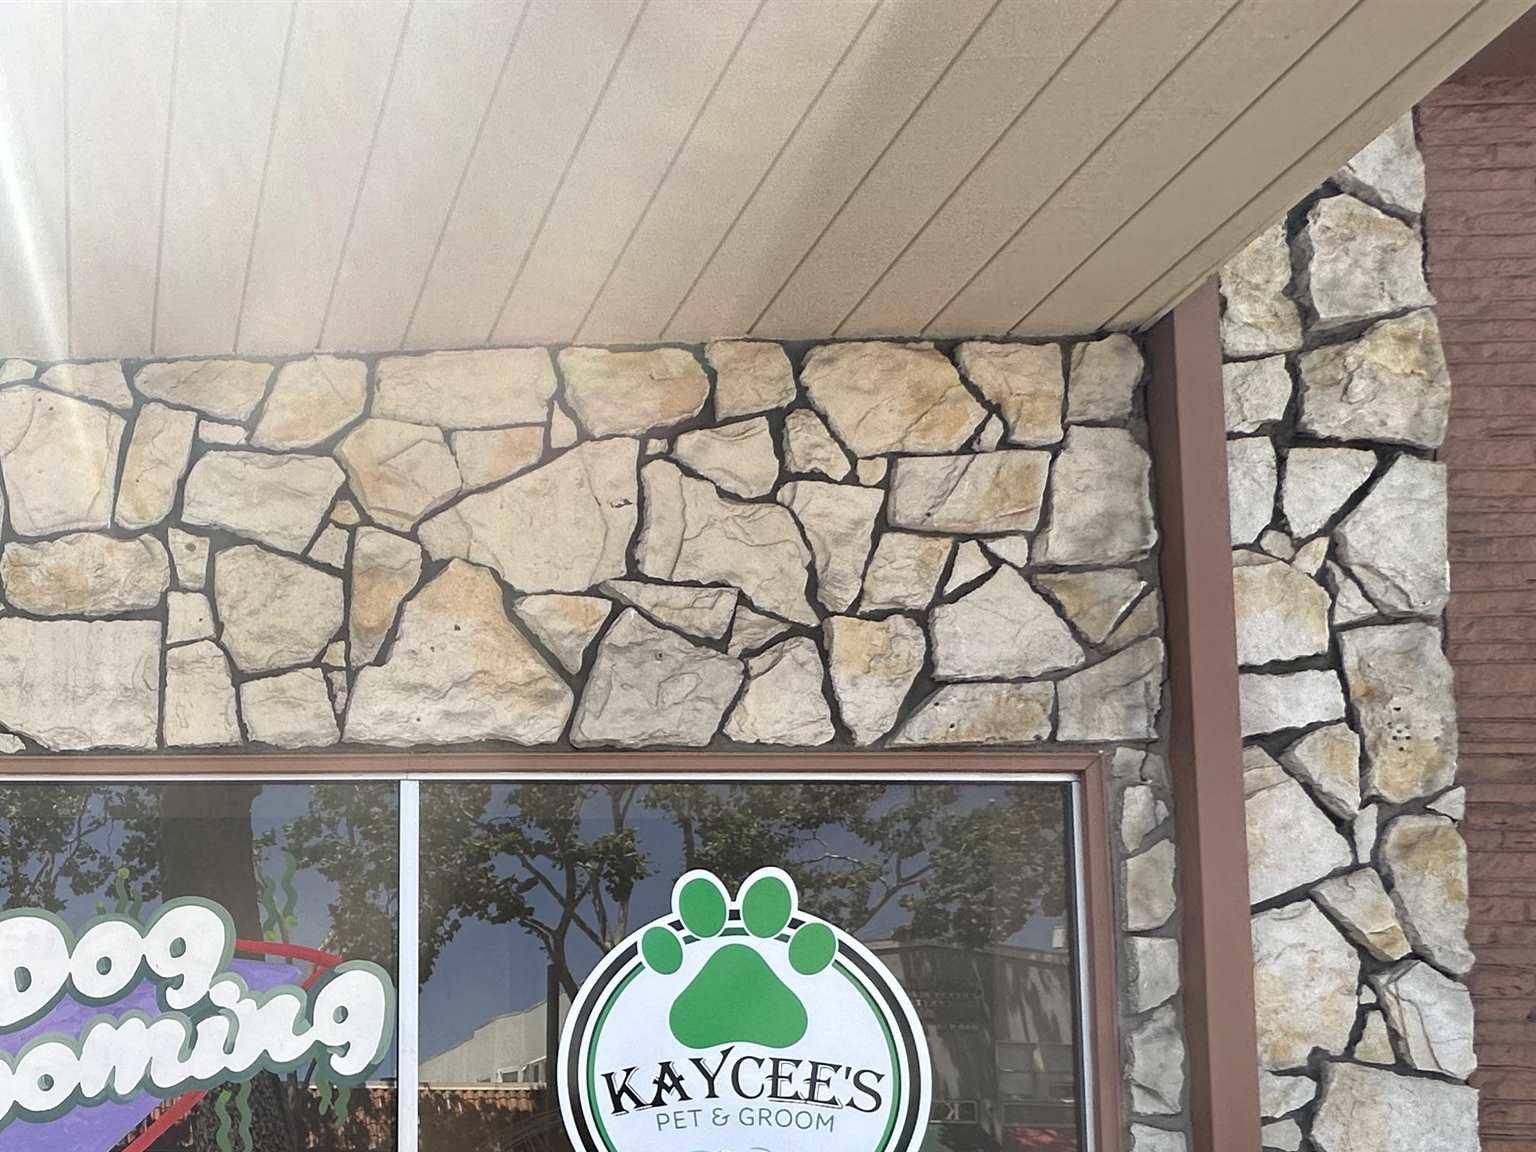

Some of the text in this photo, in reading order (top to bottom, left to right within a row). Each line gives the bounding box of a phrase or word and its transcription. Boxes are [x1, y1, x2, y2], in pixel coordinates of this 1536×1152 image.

[600, 1044, 886, 1117] KAYCEE'S
[655, 1106, 836, 1133] PET & GROOM
